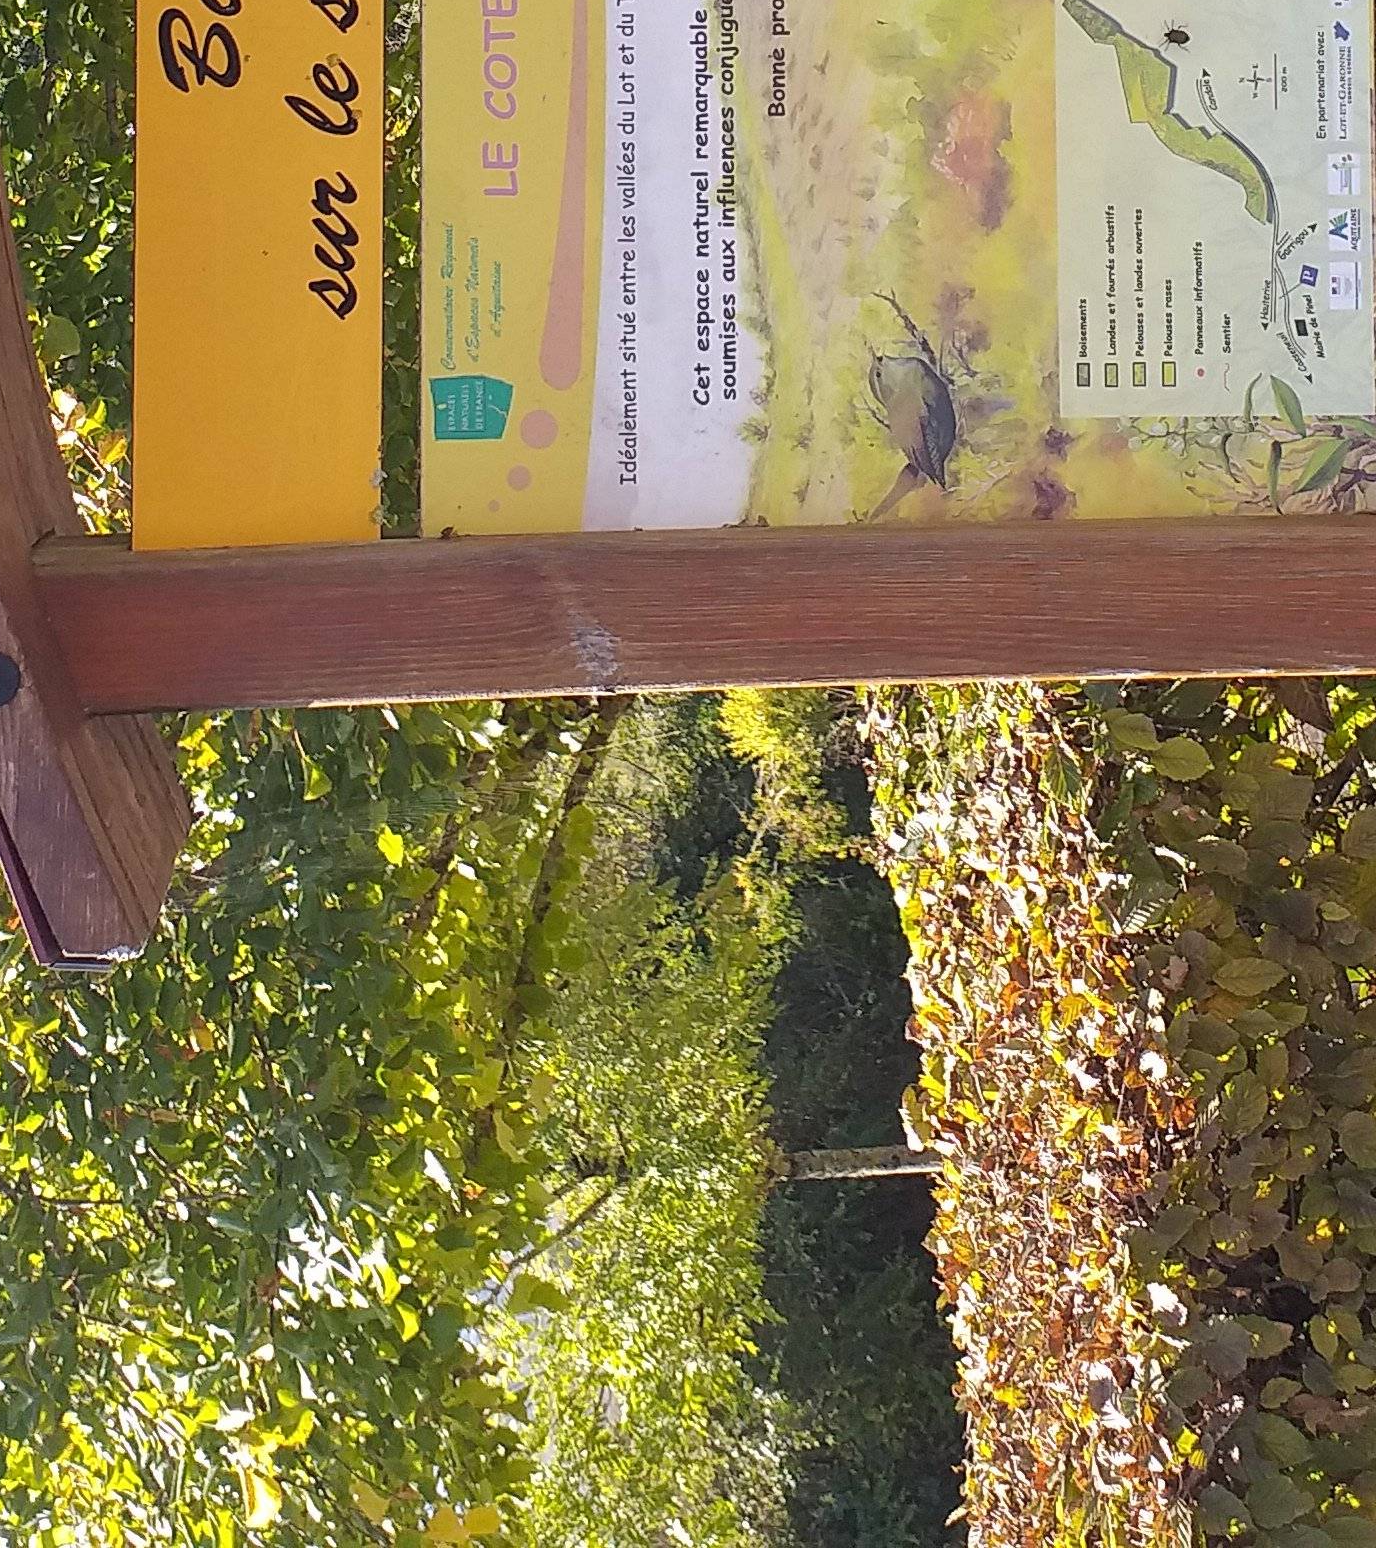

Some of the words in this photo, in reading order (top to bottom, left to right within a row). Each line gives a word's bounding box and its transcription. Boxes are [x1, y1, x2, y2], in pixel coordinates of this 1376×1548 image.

[616, 14, 634, 37] du
[618, 44, 635, 65] et
[284, 61, 359, 136] le
[616, 72, 635, 105] Lot
[689, 10, 714, 159] remarquable
[767, 47, 785, 117] Bonne
[1316, 59, 1328, 122] partenariat
[616, 112, 635, 135] du
[1316, 125, 1326, 139] En
[481, 142, 519, 197] LE
[616, 142, 635, 209] vallées
[716, 107, 737, 227] influences
[617, 216, 635, 243] les
[690, 172, 709, 257] naturel
[1105, 205, 1115, 254] arbustifs
[1134, 209, 1143, 255] ouvertes
[308, 172, 359, 320] sur
[722, 239, 735, 282] aux
[619, 250, 636, 305] entre
[1105, 258, 1116, 297] fourrés
[1134, 259, 1143, 292] landes
[1192, 241, 1204, 301] informatifs
[696, 269, 715, 352] espace
[1108, 302, 1116, 314] et
[1136, 297, 1143, 309] et
[616, 312, 637, 363] situé
[718, 294, 737, 400] soumises
[1078, 299, 1087, 358] Boisements
[1106, 318, 1116, 356] Landes
[1135, 313, 1144, 357] Pelouses
[1164, 312, 1173, 357] Pelouses
[1194, 305, 1203, 354] Panneaux
[1222, 314, 1231, 353] Sentier
[692, 363, 711, 406] Cet
[618, 369, 637, 485] Idéalement
